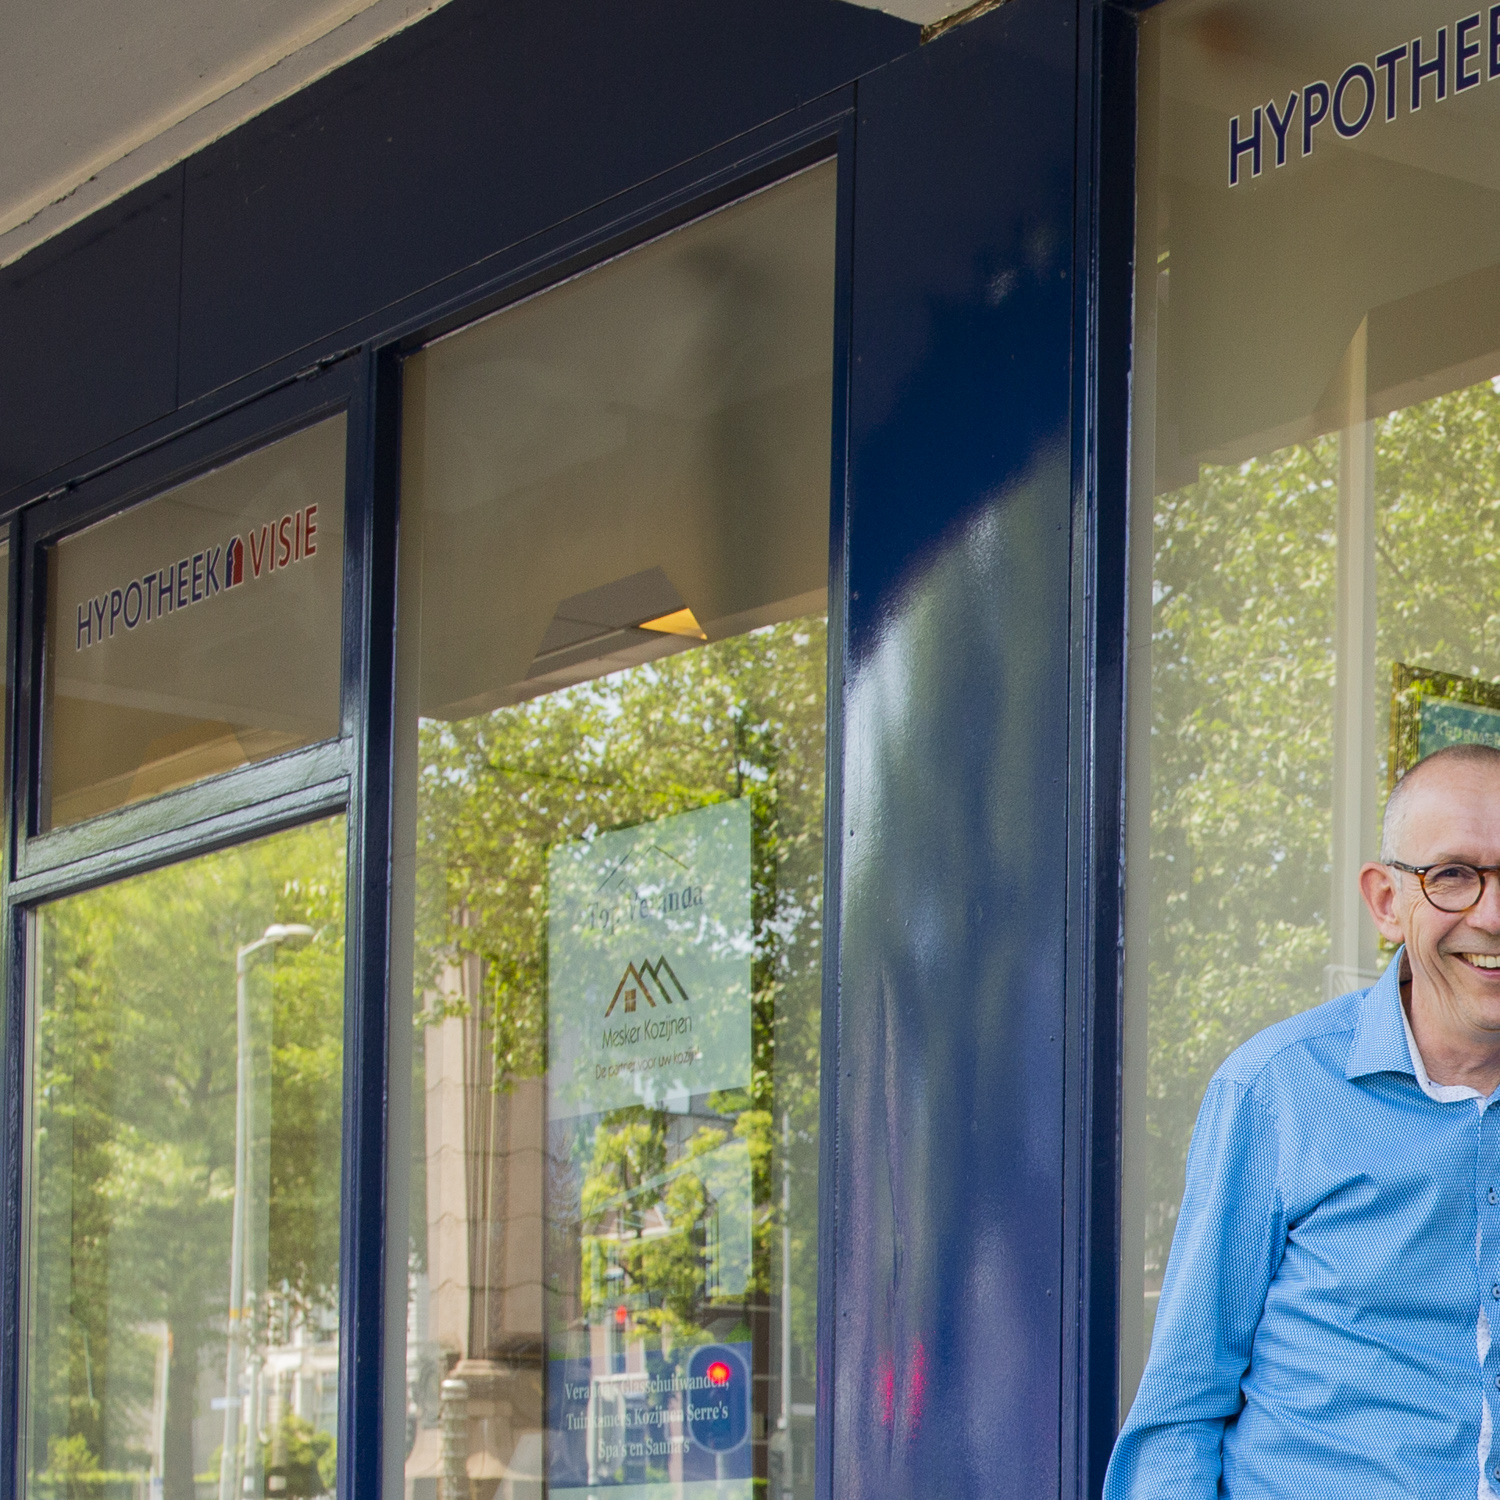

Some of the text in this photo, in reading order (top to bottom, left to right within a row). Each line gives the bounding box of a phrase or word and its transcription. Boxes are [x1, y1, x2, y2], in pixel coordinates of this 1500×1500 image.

[76, 503, 318, 652] HYPOTHEEK VISIE
[629, 886, 704, 921] Veanda
[602, 1015, 692, 1049] Mesker Kozijnen
[687, 1401, 729, 1421] Serre's
[630, 1443, 643, 1456] en
